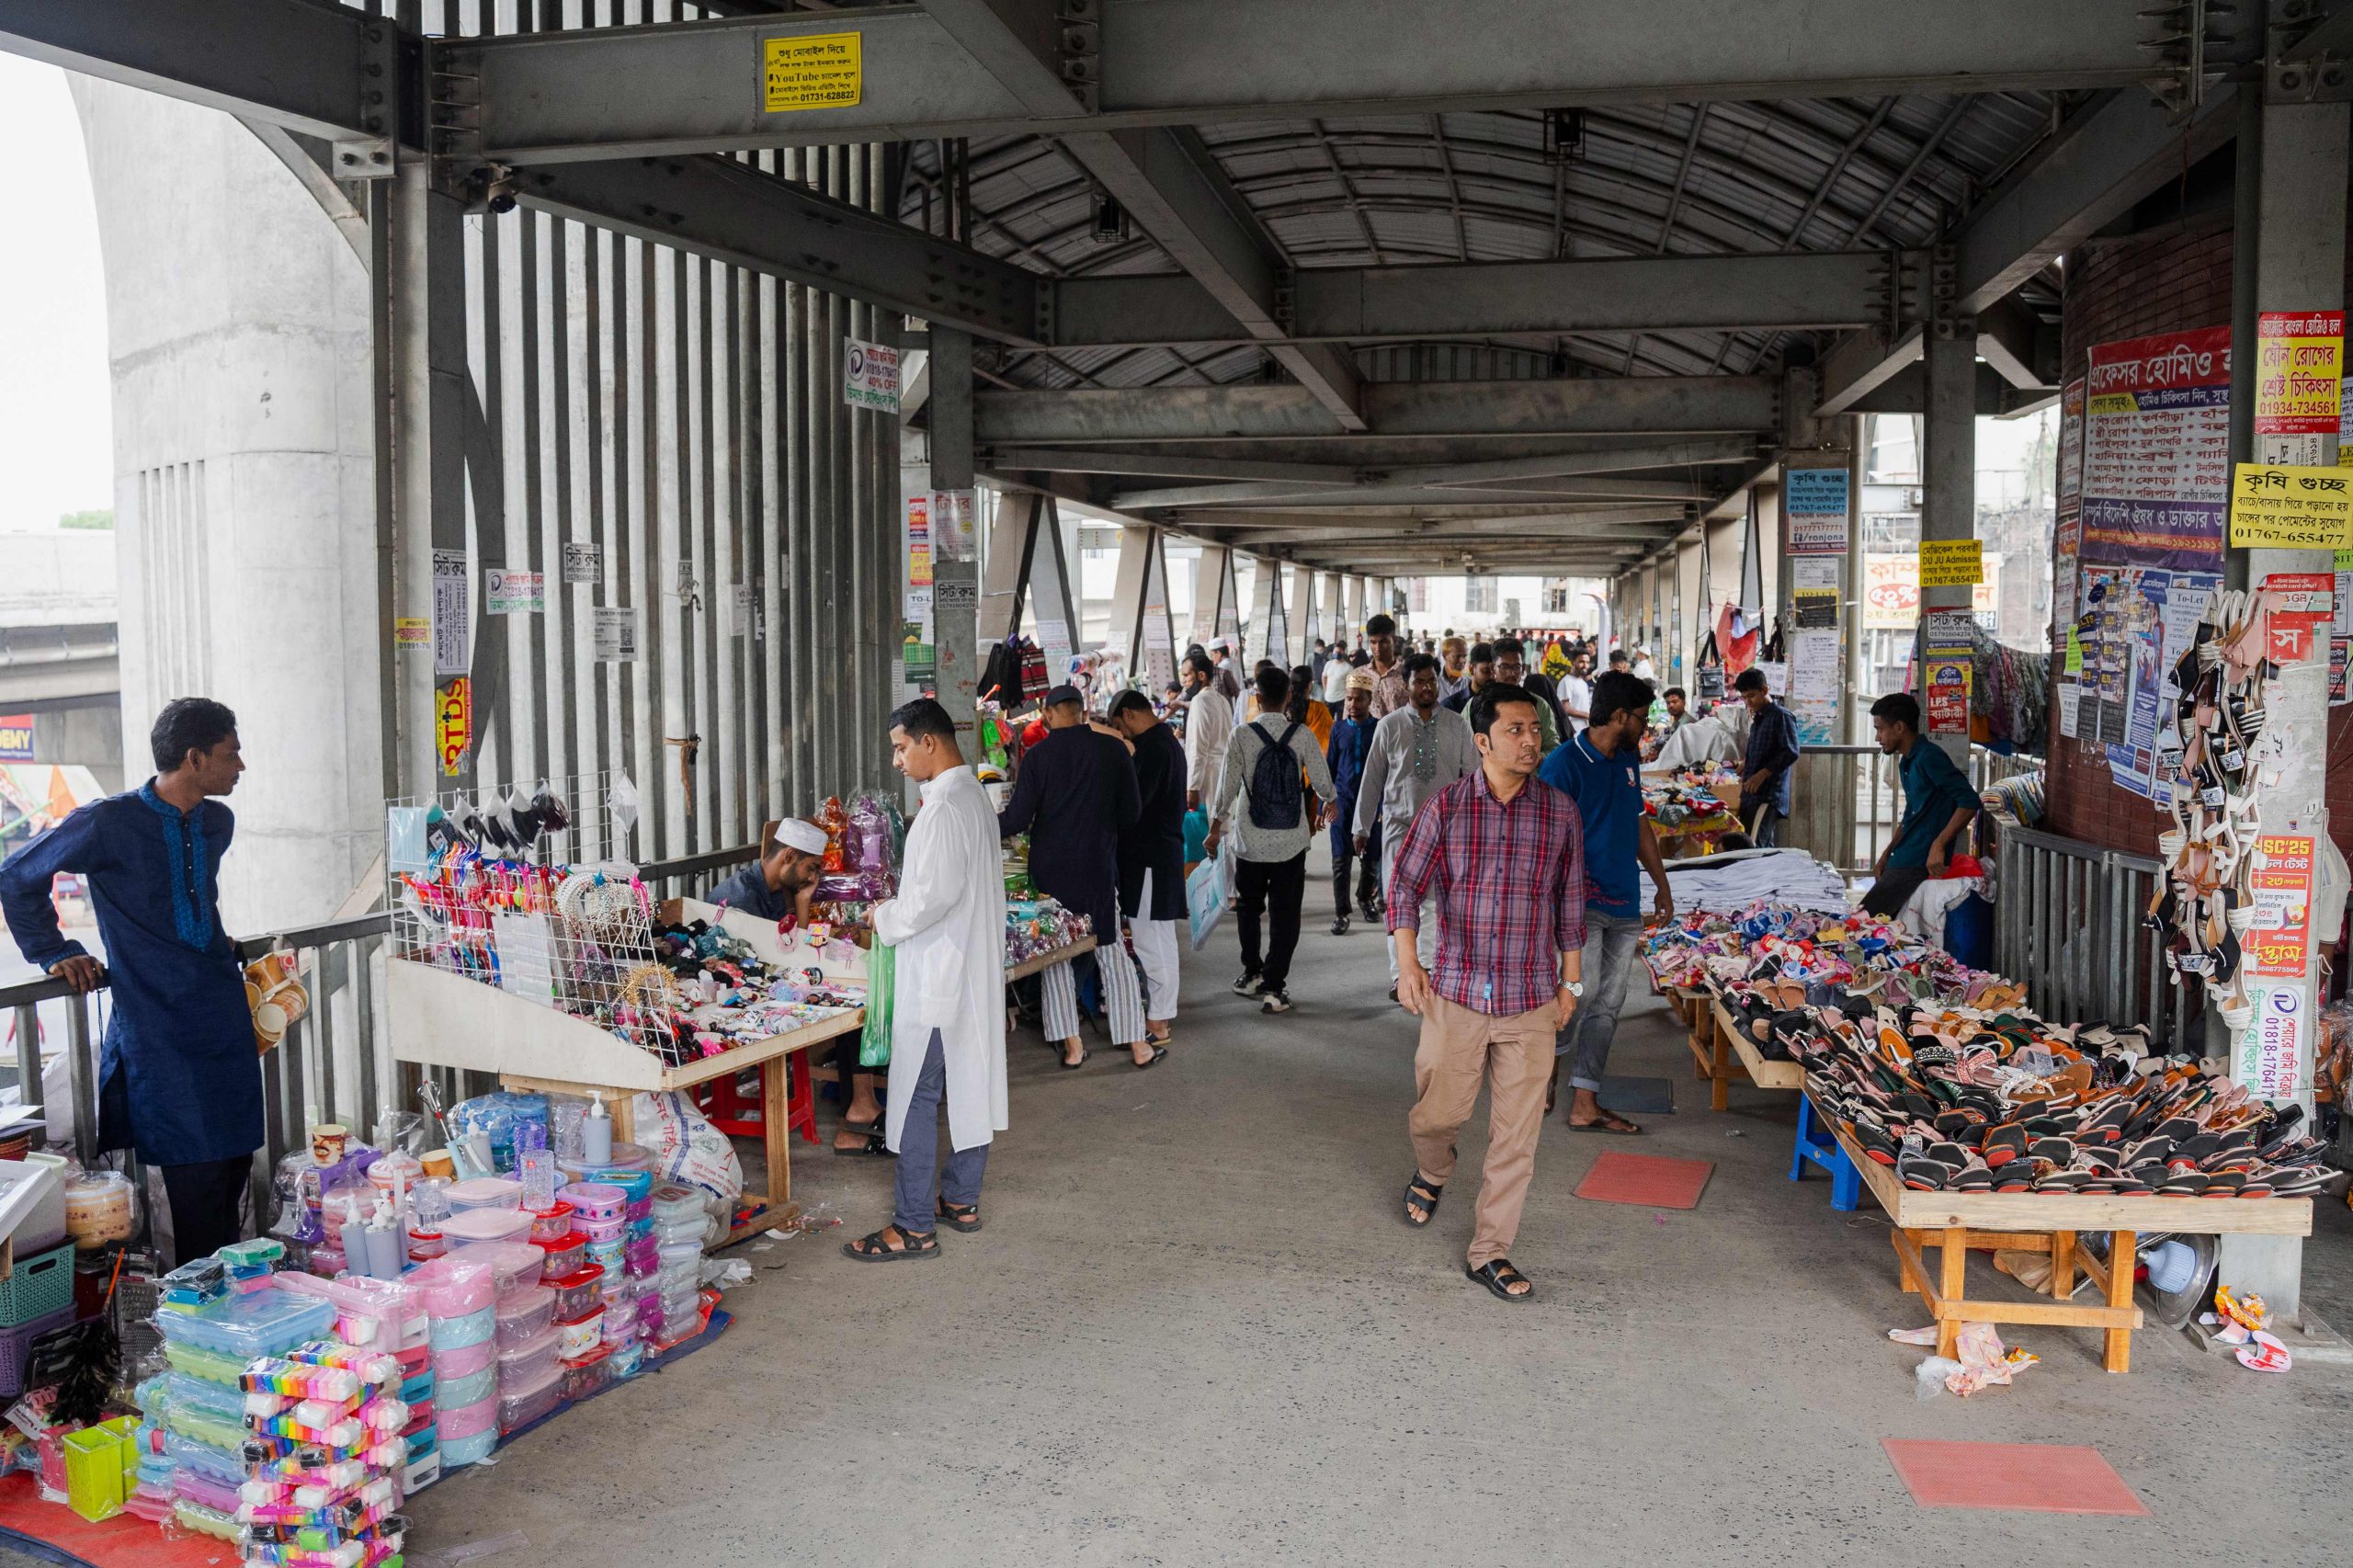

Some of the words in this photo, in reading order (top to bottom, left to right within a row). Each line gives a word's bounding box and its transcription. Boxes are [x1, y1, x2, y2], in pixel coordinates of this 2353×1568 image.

[793, 46, 824, 56] মোবাইল
[827, 43, 846, 54] দিয়ে
[776, 72, 819, 83] YouTube
[801, 90, 855, 102] 01731-628822
[2285, 319, 2304, 335] বাংলা
[2329, 319, 2341, 335] হল
[2295, 344, 2336, 367] রোগের
[2091, 359, 2142, 390] প্রফেসর
[2145, 344, 2212, 386] হোমিও
[884, 379, 897, 391] OFF
[2290, 371, 2336, 398] চিকিৎসা
[2137, 392, 2160, 408] হোমিও
[2161, 390, 2189, 405] চিকিৎসা
[2259, 401, 2336, 415] 01934-734561
[2111, 415, 2131, 426] রোগ
[2108, 427, 2129, 437] রোগ
[2243, 471, 2290, 494] কৃষি
[2299, 477, 2349, 494] গুচ্ছ
[2135, 486, 2177, 499] পলিপাস
[2237, 496, 2281, 509] ব্যাচে/বাসায়
[2284, 496, 2303, 509] গিয়ে
[2305, 500, 2334, 512] পড়ানো
[2336, 501, 2349, 512] হয়
[2131, 503, 2154, 527] ঔষধ
[2169, 508, 2210, 529] ডাক্তার
[2263, 515, 2276, 525] পর
[2278, 515, 2317, 528] পেমেন্টের
[2319, 517, 2346, 531] সুযোগ
[2234, 528, 2345, 544] 01767-655477
[1922, 544, 1953, 555] মেডিকেল
[1922, 556, 1933, 565] DU
[1934, 556, 1944, 564] JU
[1946, 554, 1980, 564] Admisson
[1923, 574, 1980, 585] 01767-655477
[938, 584, 976, 598] সিট/রুম
[2177, 593, 2204, 604] To-Let
[2284, 857, 2309, 869] টেস্ট
[2267, 876, 2283, 886] ২৩
[2281, 1017, 2296, 1049] শেয়ারে
[2279, 1051, 2299, 1070] জমি
[2279, 1073, 2298, 1098] বিক্রয়
